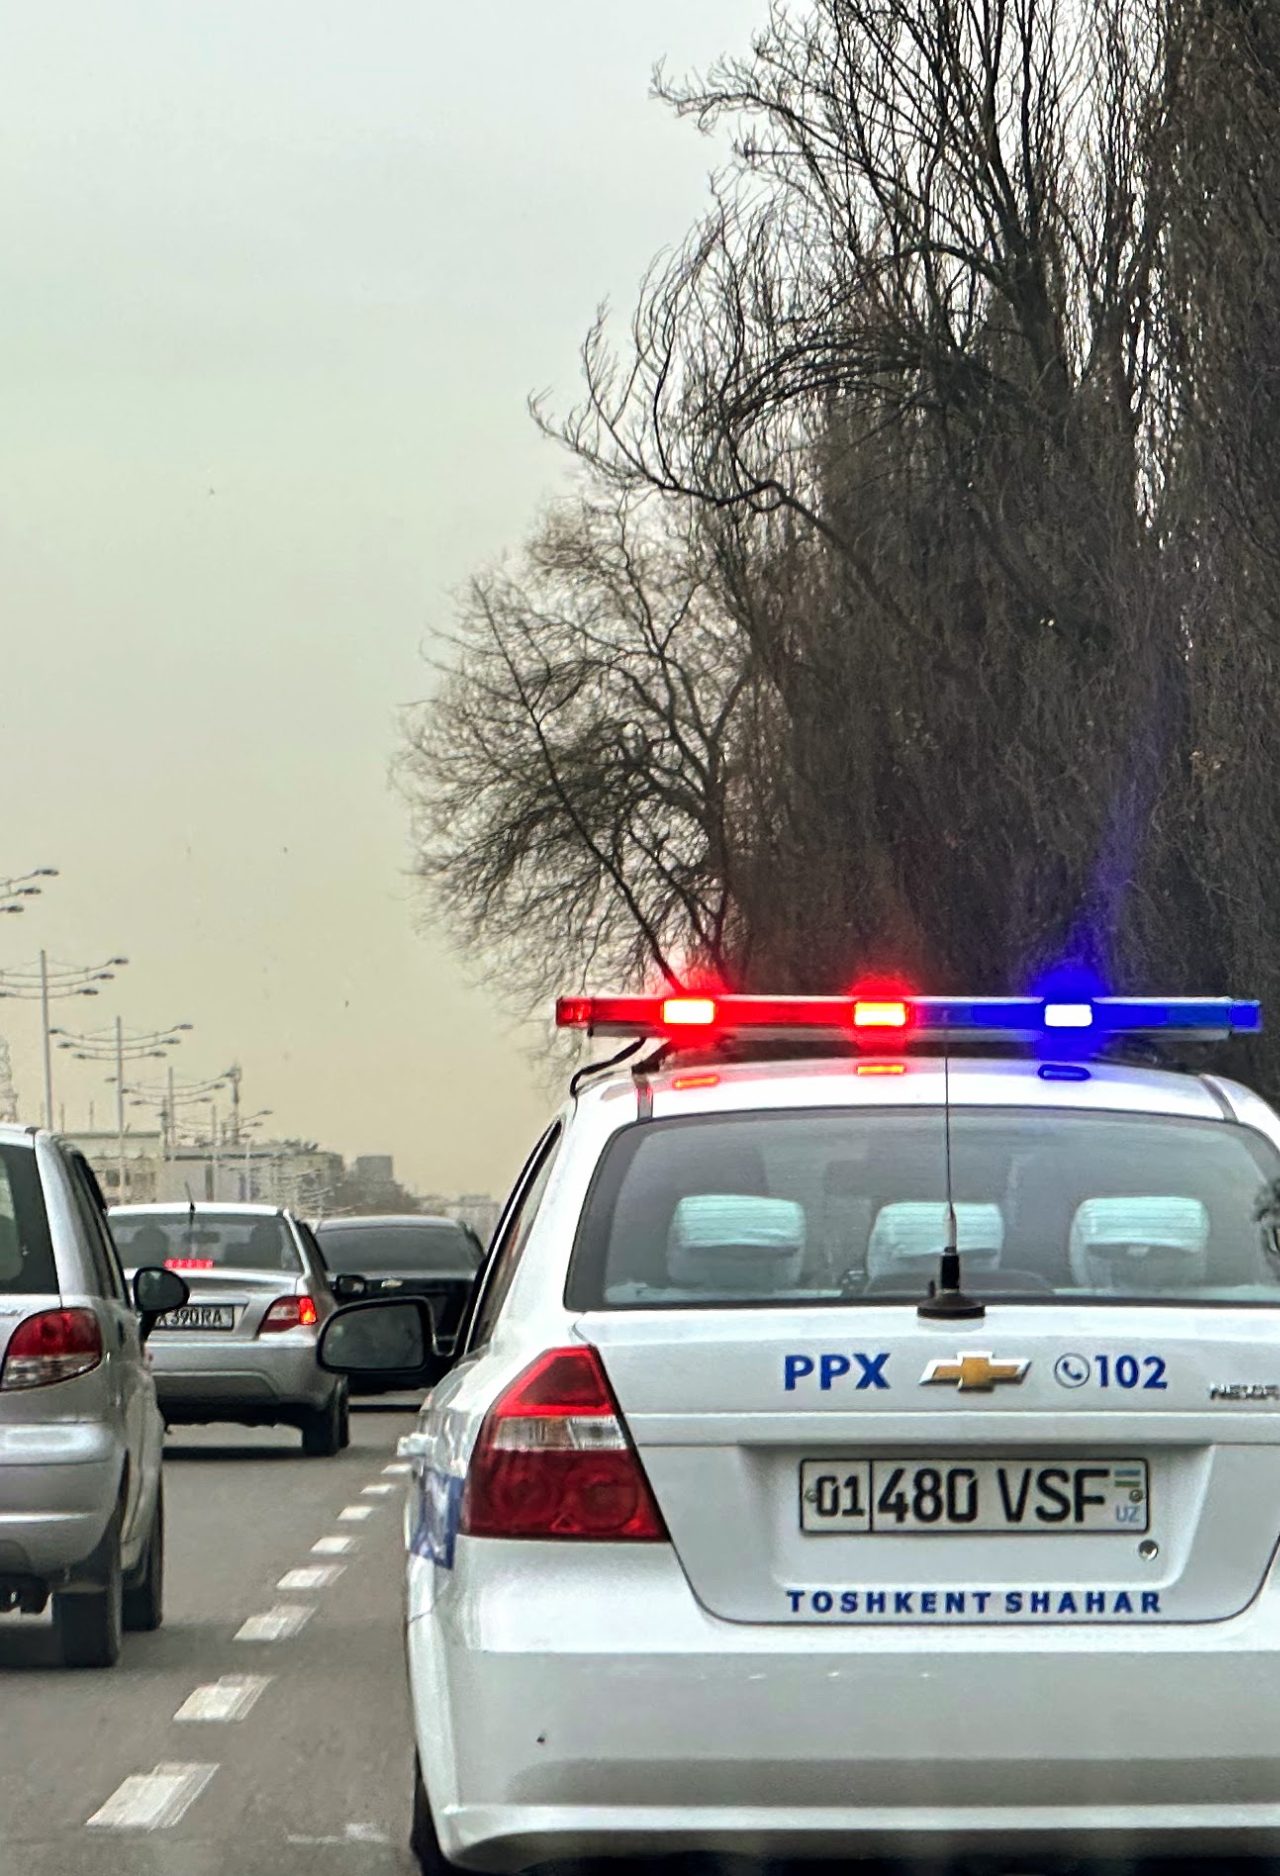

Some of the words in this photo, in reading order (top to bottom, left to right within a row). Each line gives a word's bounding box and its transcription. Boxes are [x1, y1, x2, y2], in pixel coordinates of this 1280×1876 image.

[784, 1353, 892, 1390] PPX
[1095, 1355, 1168, 1390] 102
[815, 1476, 865, 1517] 01
[877, 1468, 978, 1523] 480
[997, 1468, 1111, 1523] VSF
[1115, 1506, 1140, 1523] UZ
[786, 1590, 991, 1613] TOSHKENT
[1004, 1590, 1162, 1613] SHAHAR
